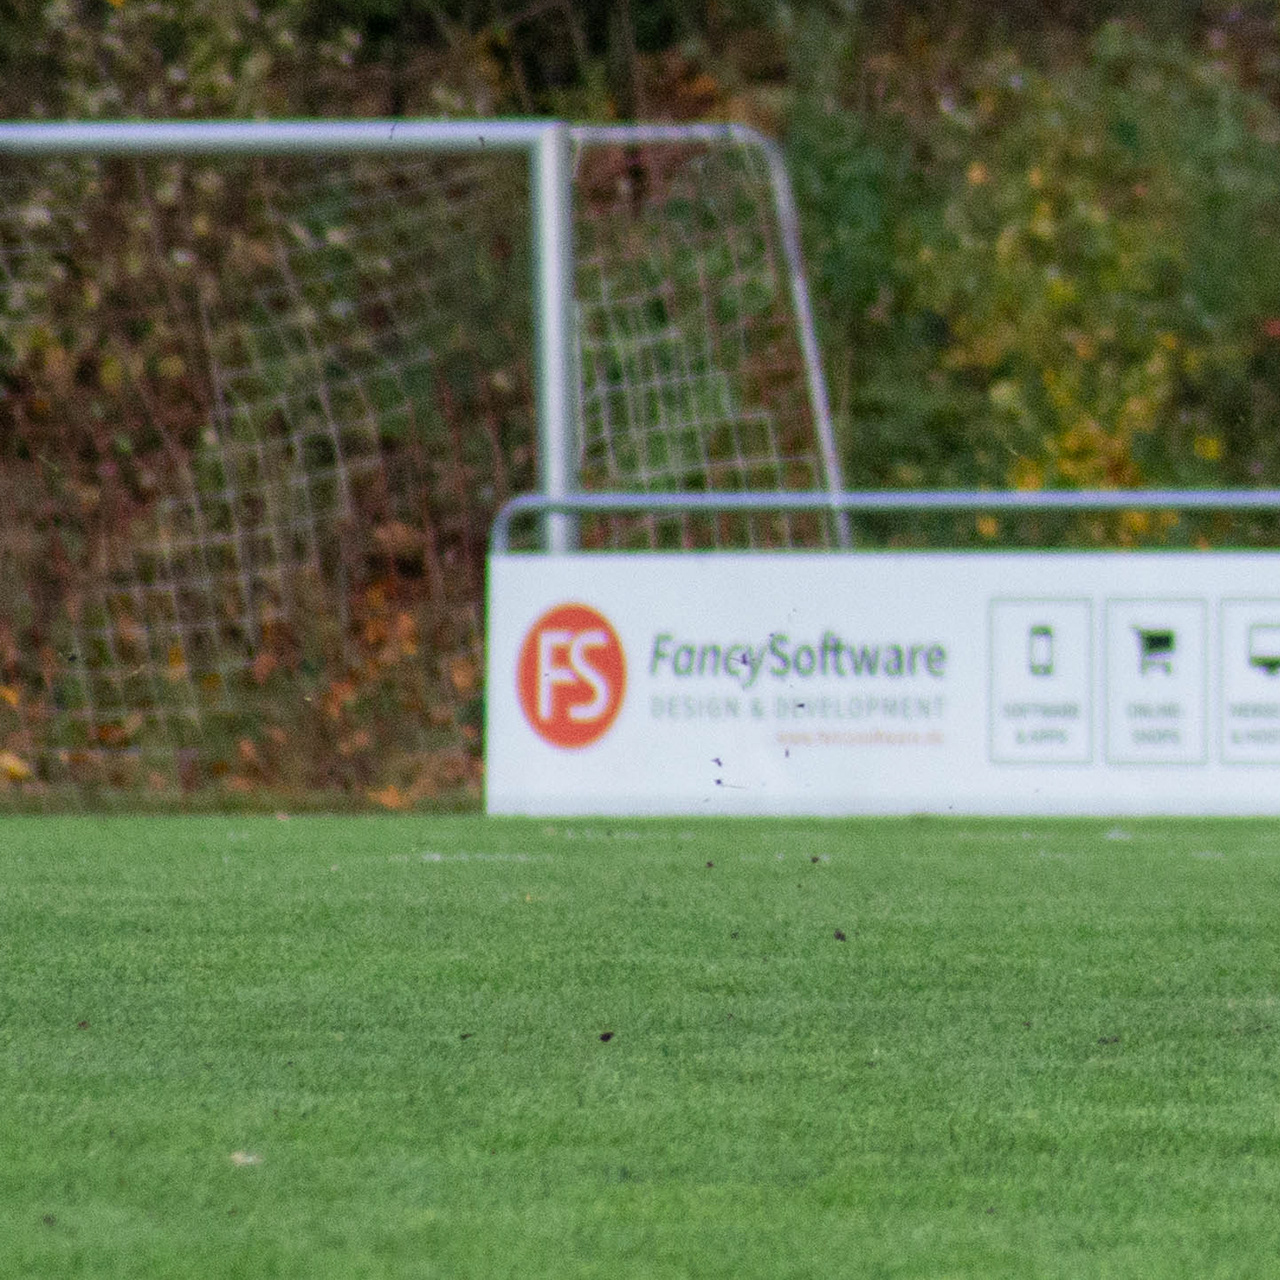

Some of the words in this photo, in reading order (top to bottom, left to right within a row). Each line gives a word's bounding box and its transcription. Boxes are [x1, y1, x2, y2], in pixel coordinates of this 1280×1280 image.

[537, 629, 609, 721] FS
[649, 631, 949, 689] FancySoftware
[650, 696, 740, 720] DESIGN
[775, 695, 945, 720] DEVELOPMENT
